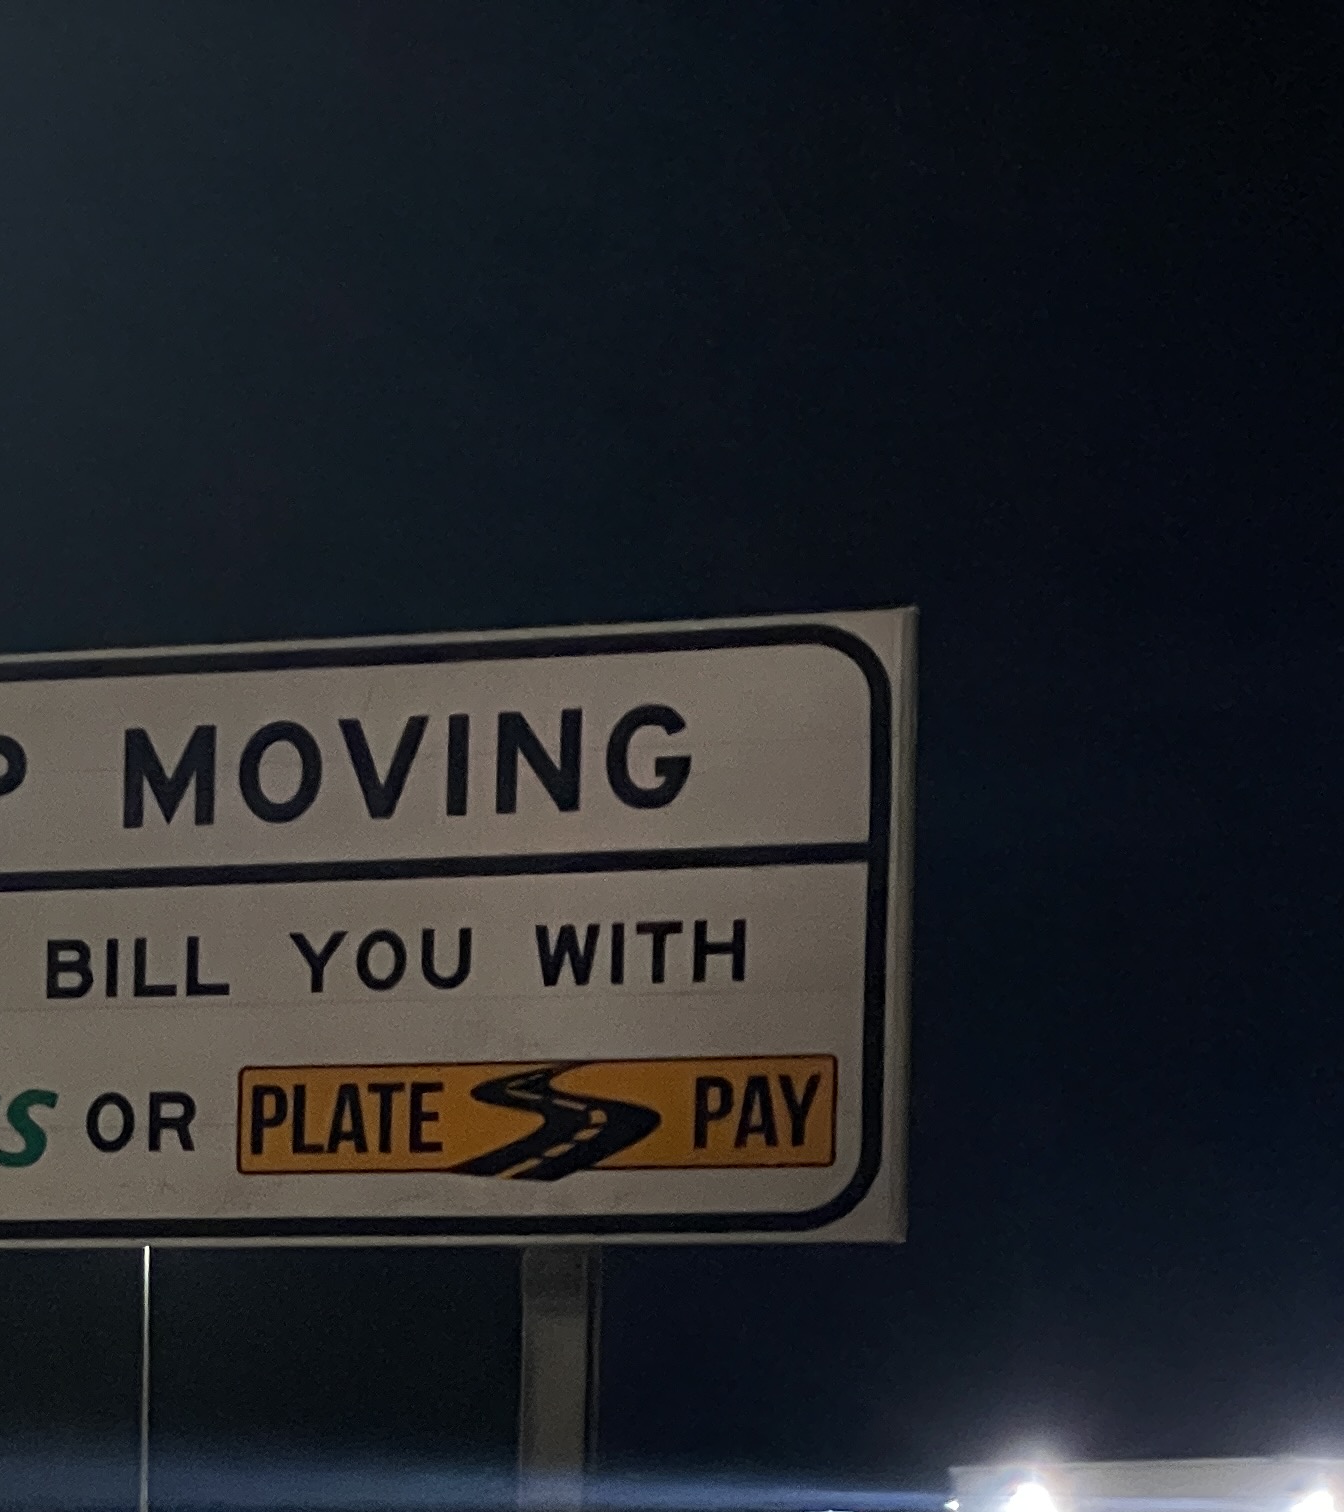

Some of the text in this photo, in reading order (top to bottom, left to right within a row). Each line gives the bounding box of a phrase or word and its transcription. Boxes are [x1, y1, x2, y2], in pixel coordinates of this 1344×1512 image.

[122, 703, 693, 829] MOVING
[45, 938, 230, 999] BILL
[290, 926, 473, 993] YOU
[535, 919, 748, 987] WITH
[85, 1092, 196, 1153] OR
[248, 1082, 443, 1156] PLATE
[692, 1073, 820, 1149] PAY
